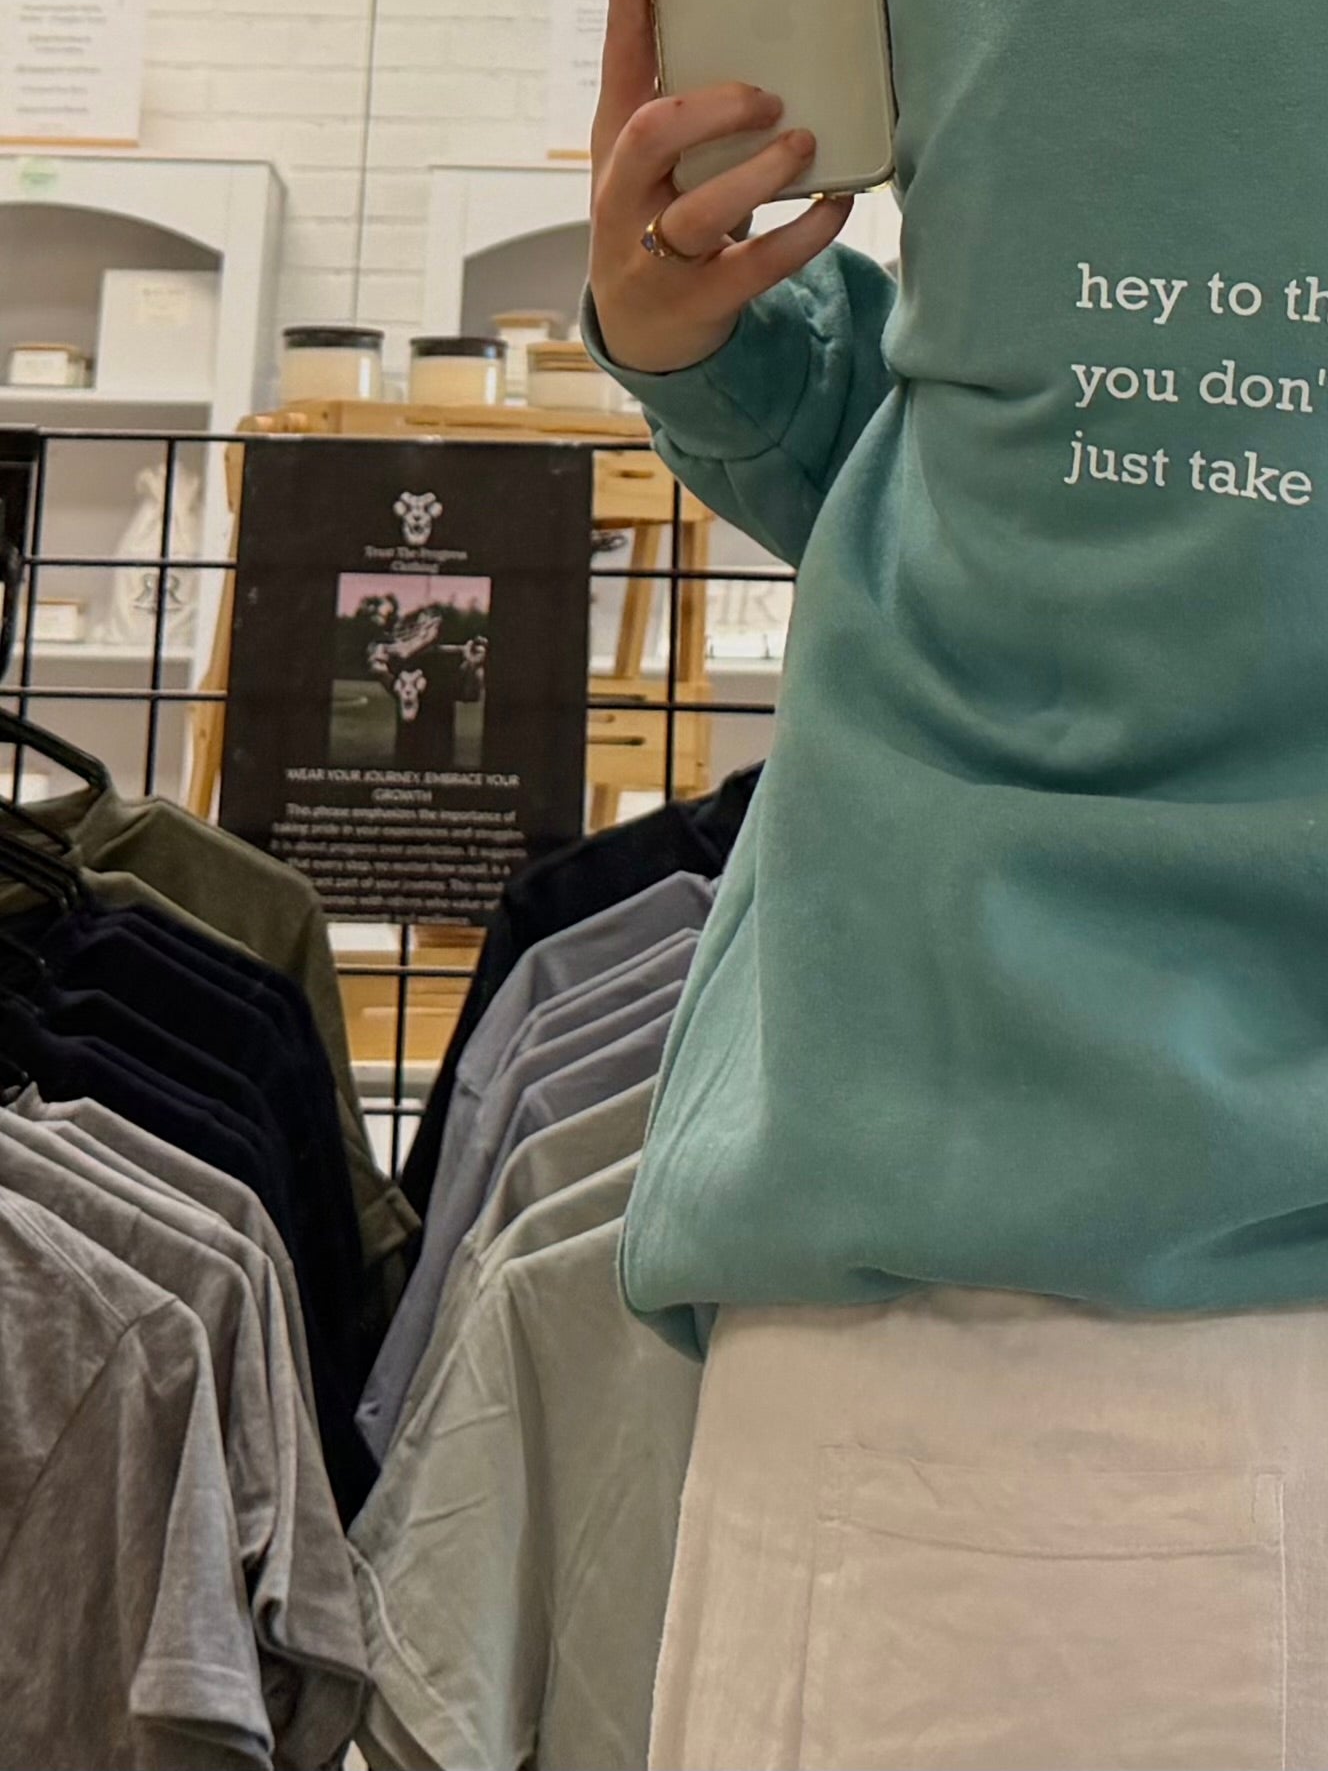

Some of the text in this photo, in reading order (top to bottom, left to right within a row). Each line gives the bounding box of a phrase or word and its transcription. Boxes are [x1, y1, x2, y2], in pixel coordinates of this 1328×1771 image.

[1075, 262, 1188, 325] hey
[1206, 271, 1263, 317] to
[1070, 363, 1179, 409] you
[1063, 429, 1170, 487] just
[1188, 450, 1313, 506] take
